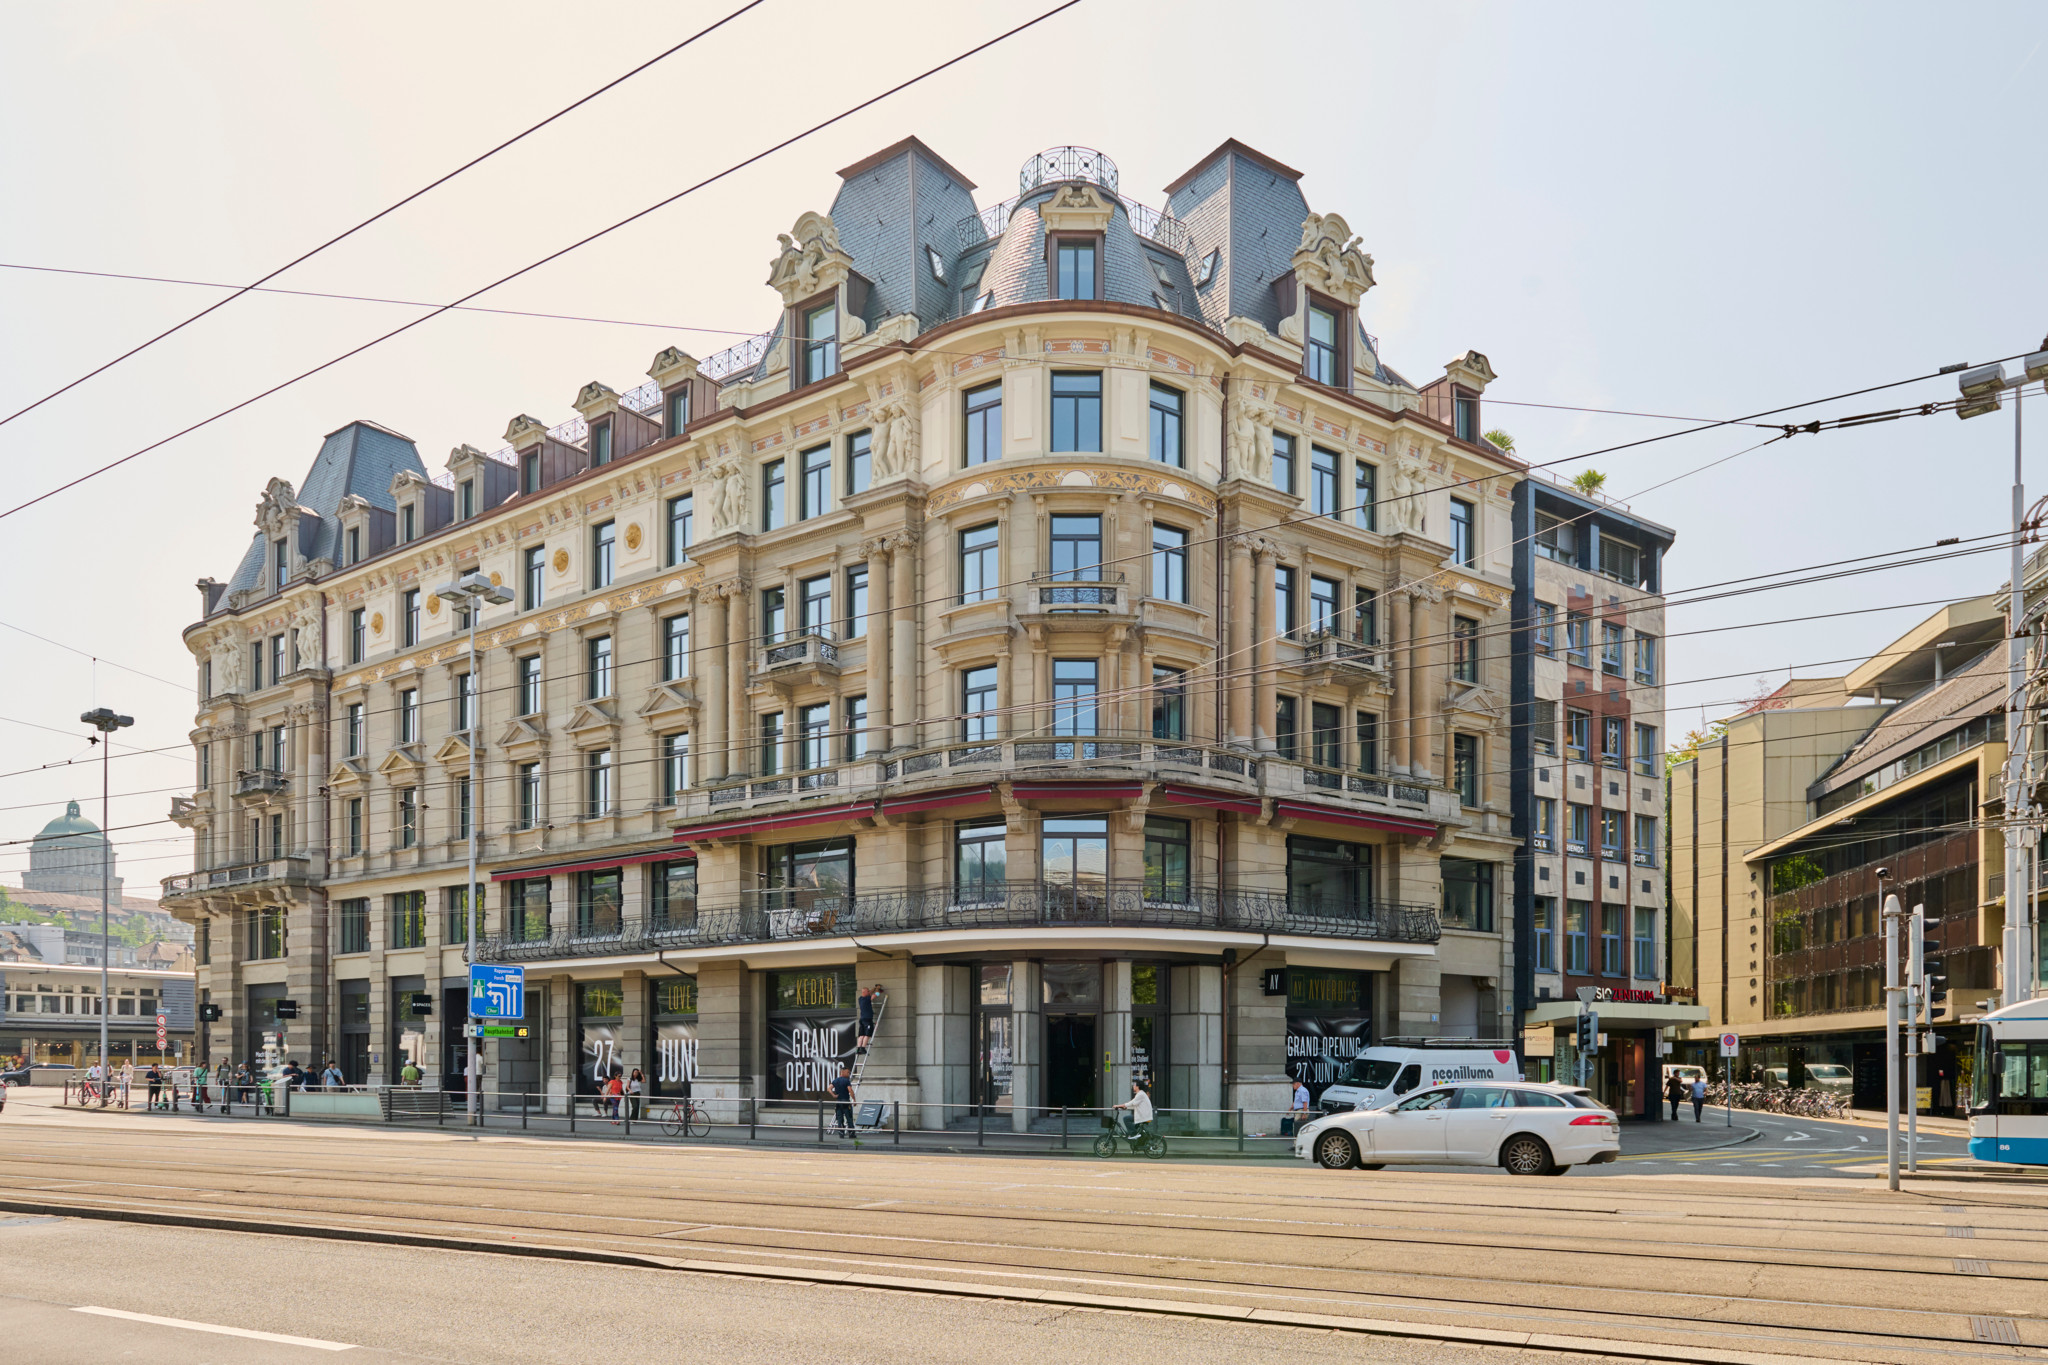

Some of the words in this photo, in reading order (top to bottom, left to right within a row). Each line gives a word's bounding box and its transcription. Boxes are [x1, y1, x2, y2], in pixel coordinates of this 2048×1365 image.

[796, 977, 833, 1006] KEBAB
[1269, 974, 1279, 990] AY
[668, 985, 691, 1011] LOVE
[518, 1028, 528, 1036] 65
[792, 1028, 839, 1059] GRAND
[1287, 1035, 1319, 1057] GRAND
[1322, 1036, 1361, 1057] OPENING
[593, 1040, 615, 1082] 27
[1313, 1062, 1334, 1083] JUNI
[1432, 1066, 1494, 1080] neonilluma
